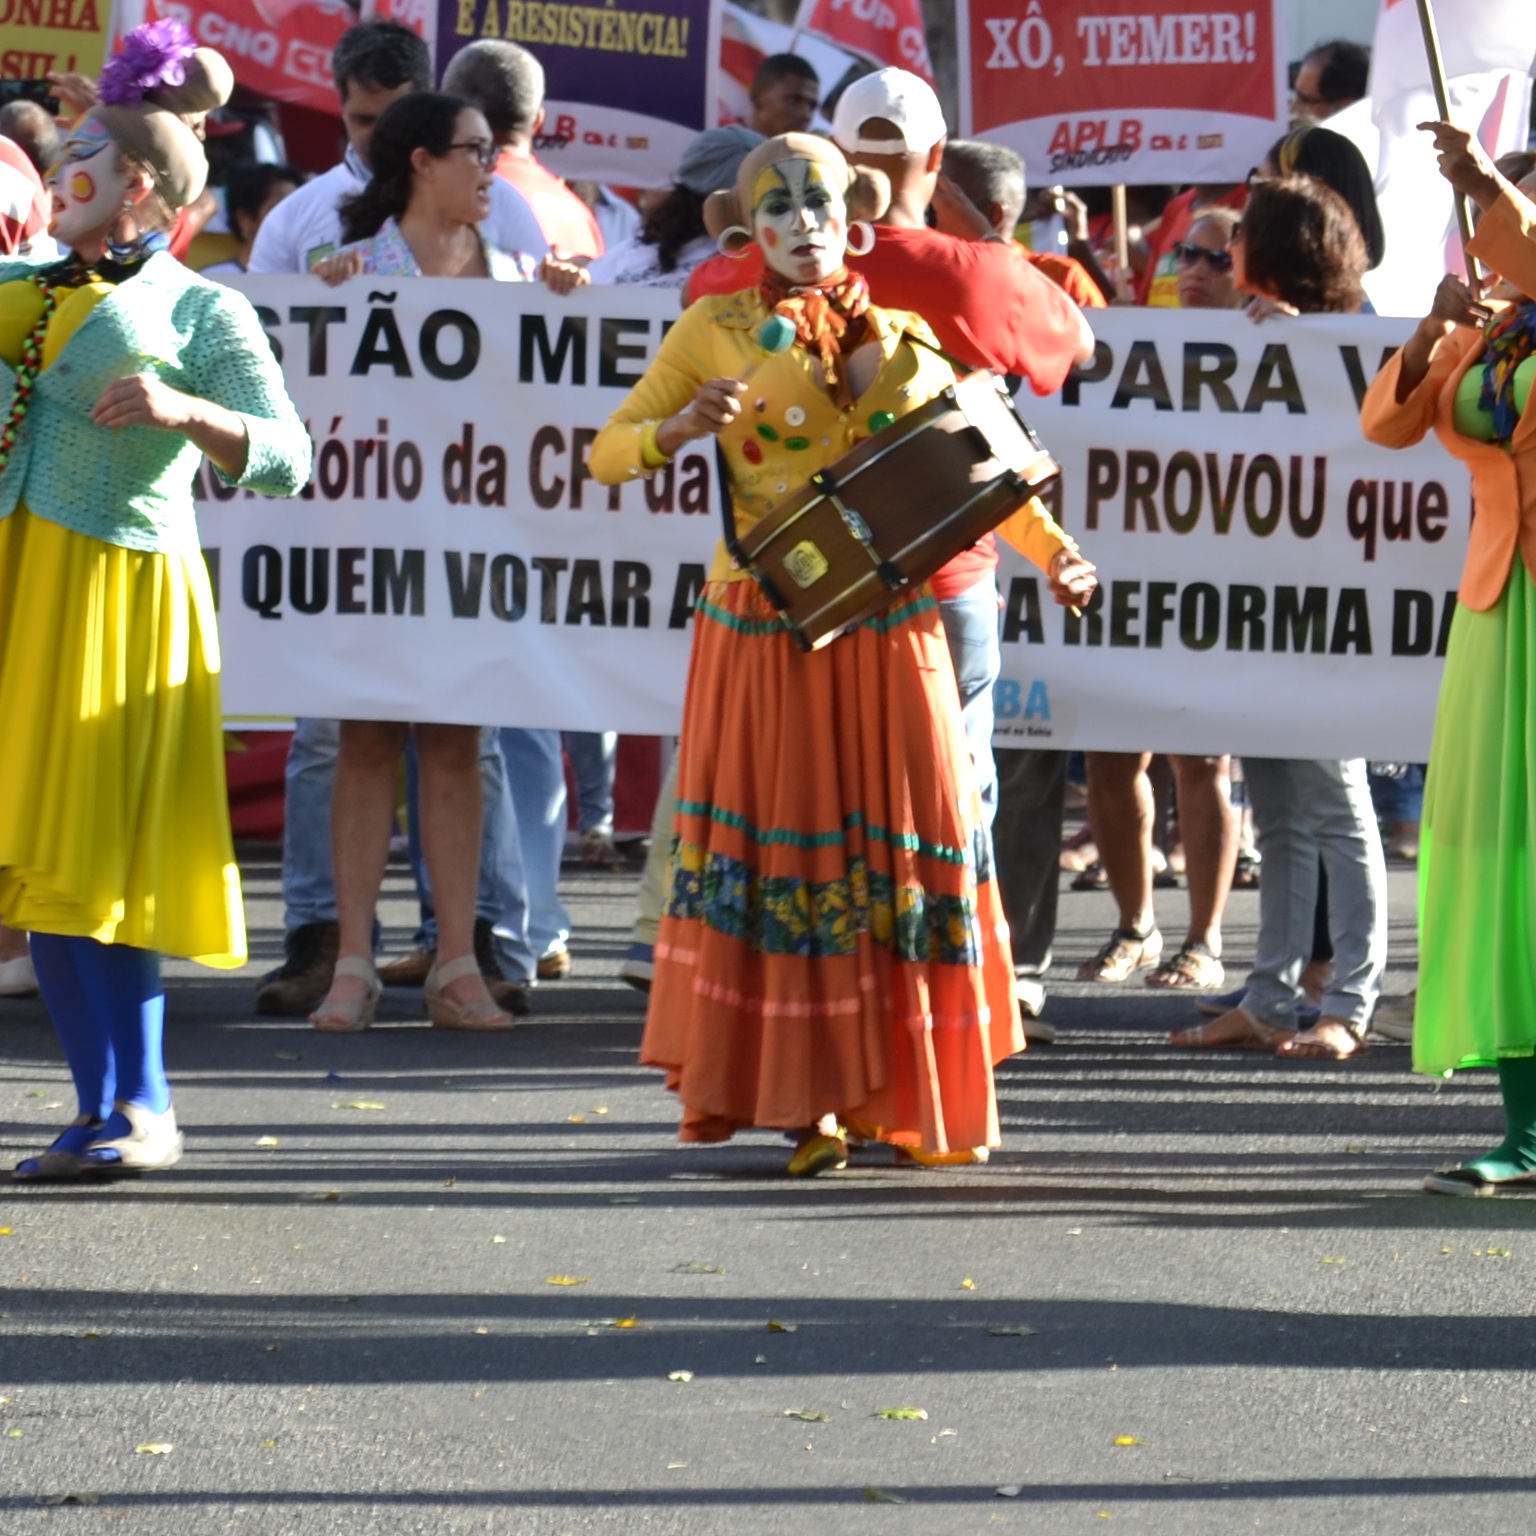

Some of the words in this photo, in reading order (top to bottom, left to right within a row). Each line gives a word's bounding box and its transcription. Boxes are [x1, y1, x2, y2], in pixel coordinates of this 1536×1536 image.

[984, 0, 1064, 77] XÔ,
[1077, 11, 1257, 66] TEMER!
[1046, 120, 1143, 156] APLB
[1061, 340, 1308, 415] PARA
[441, 421, 508, 508] da
[1084, 447, 1328, 540] PROVOU
[1346, 477, 1450, 562] que
[241, 544, 426, 621] QUEM
[443, 550, 652, 630] VOTAR
[1064, 579, 1373, 657] REFORMA
